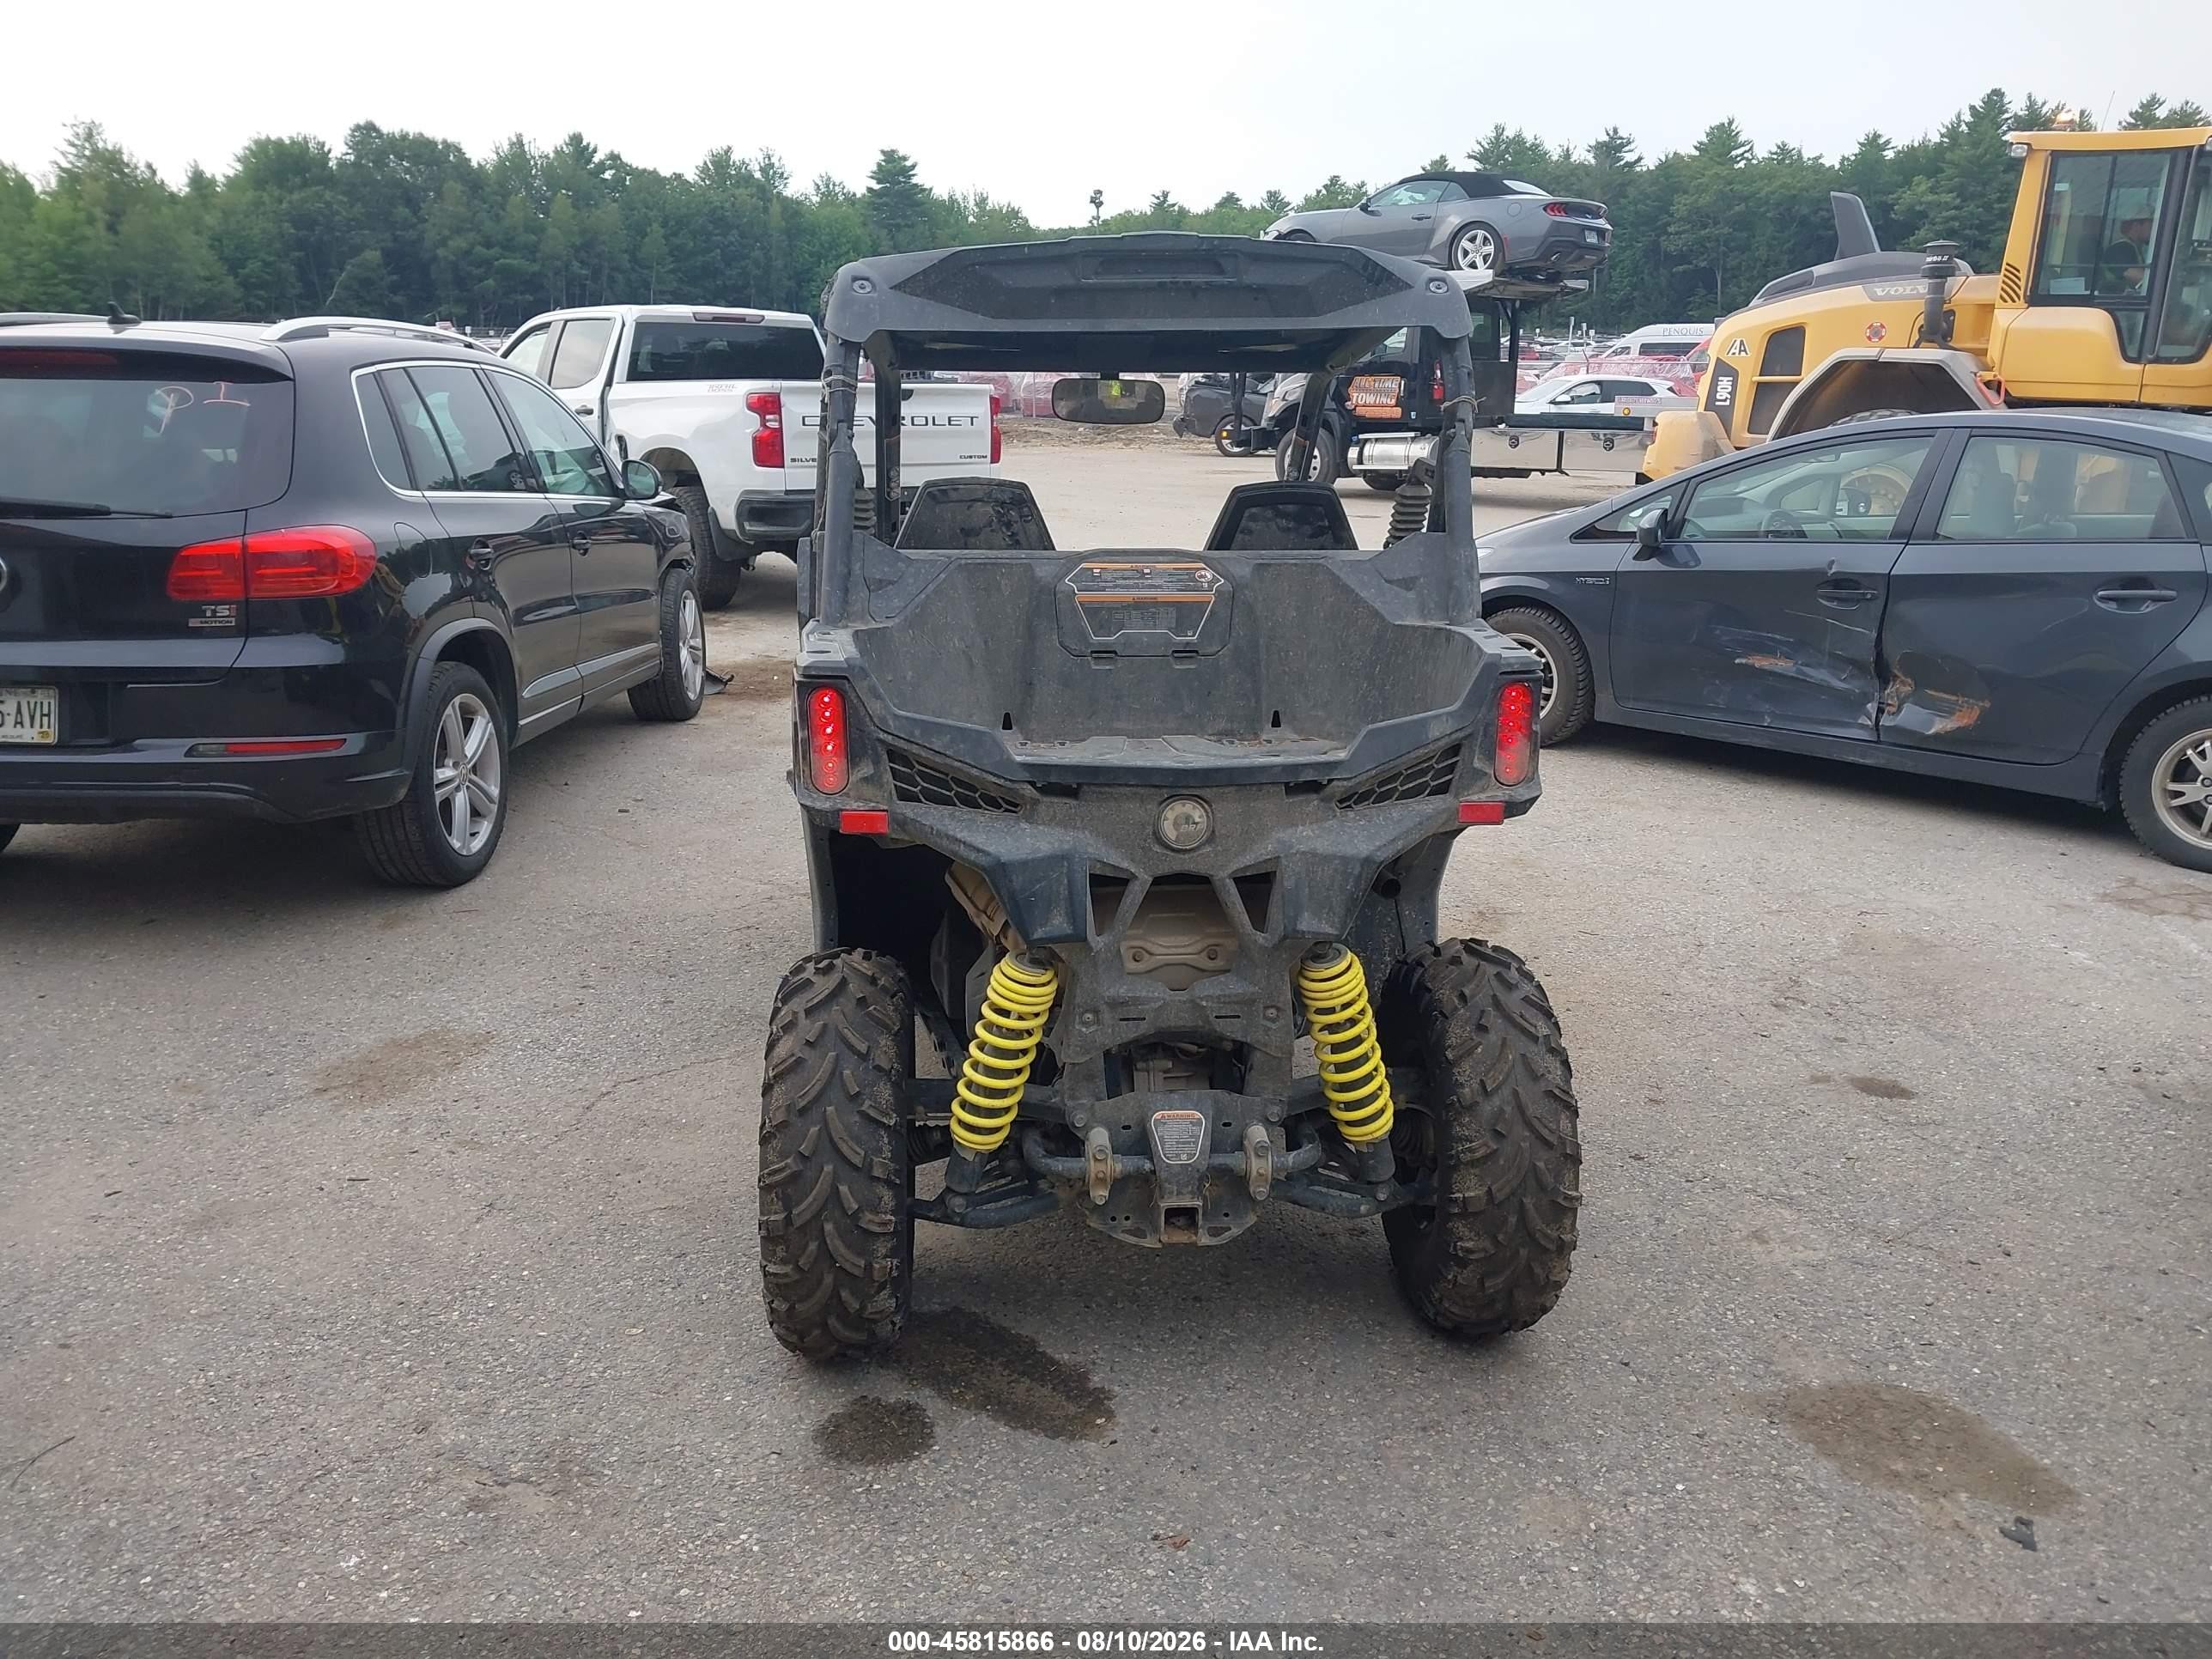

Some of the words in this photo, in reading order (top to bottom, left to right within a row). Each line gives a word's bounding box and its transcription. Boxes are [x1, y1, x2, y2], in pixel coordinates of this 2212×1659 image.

[1874, 285, 1929, 296] VOLV
[1662, 327, 1705, 336] PENQUIS
[1352, 392, 1397, 404] TOWING
